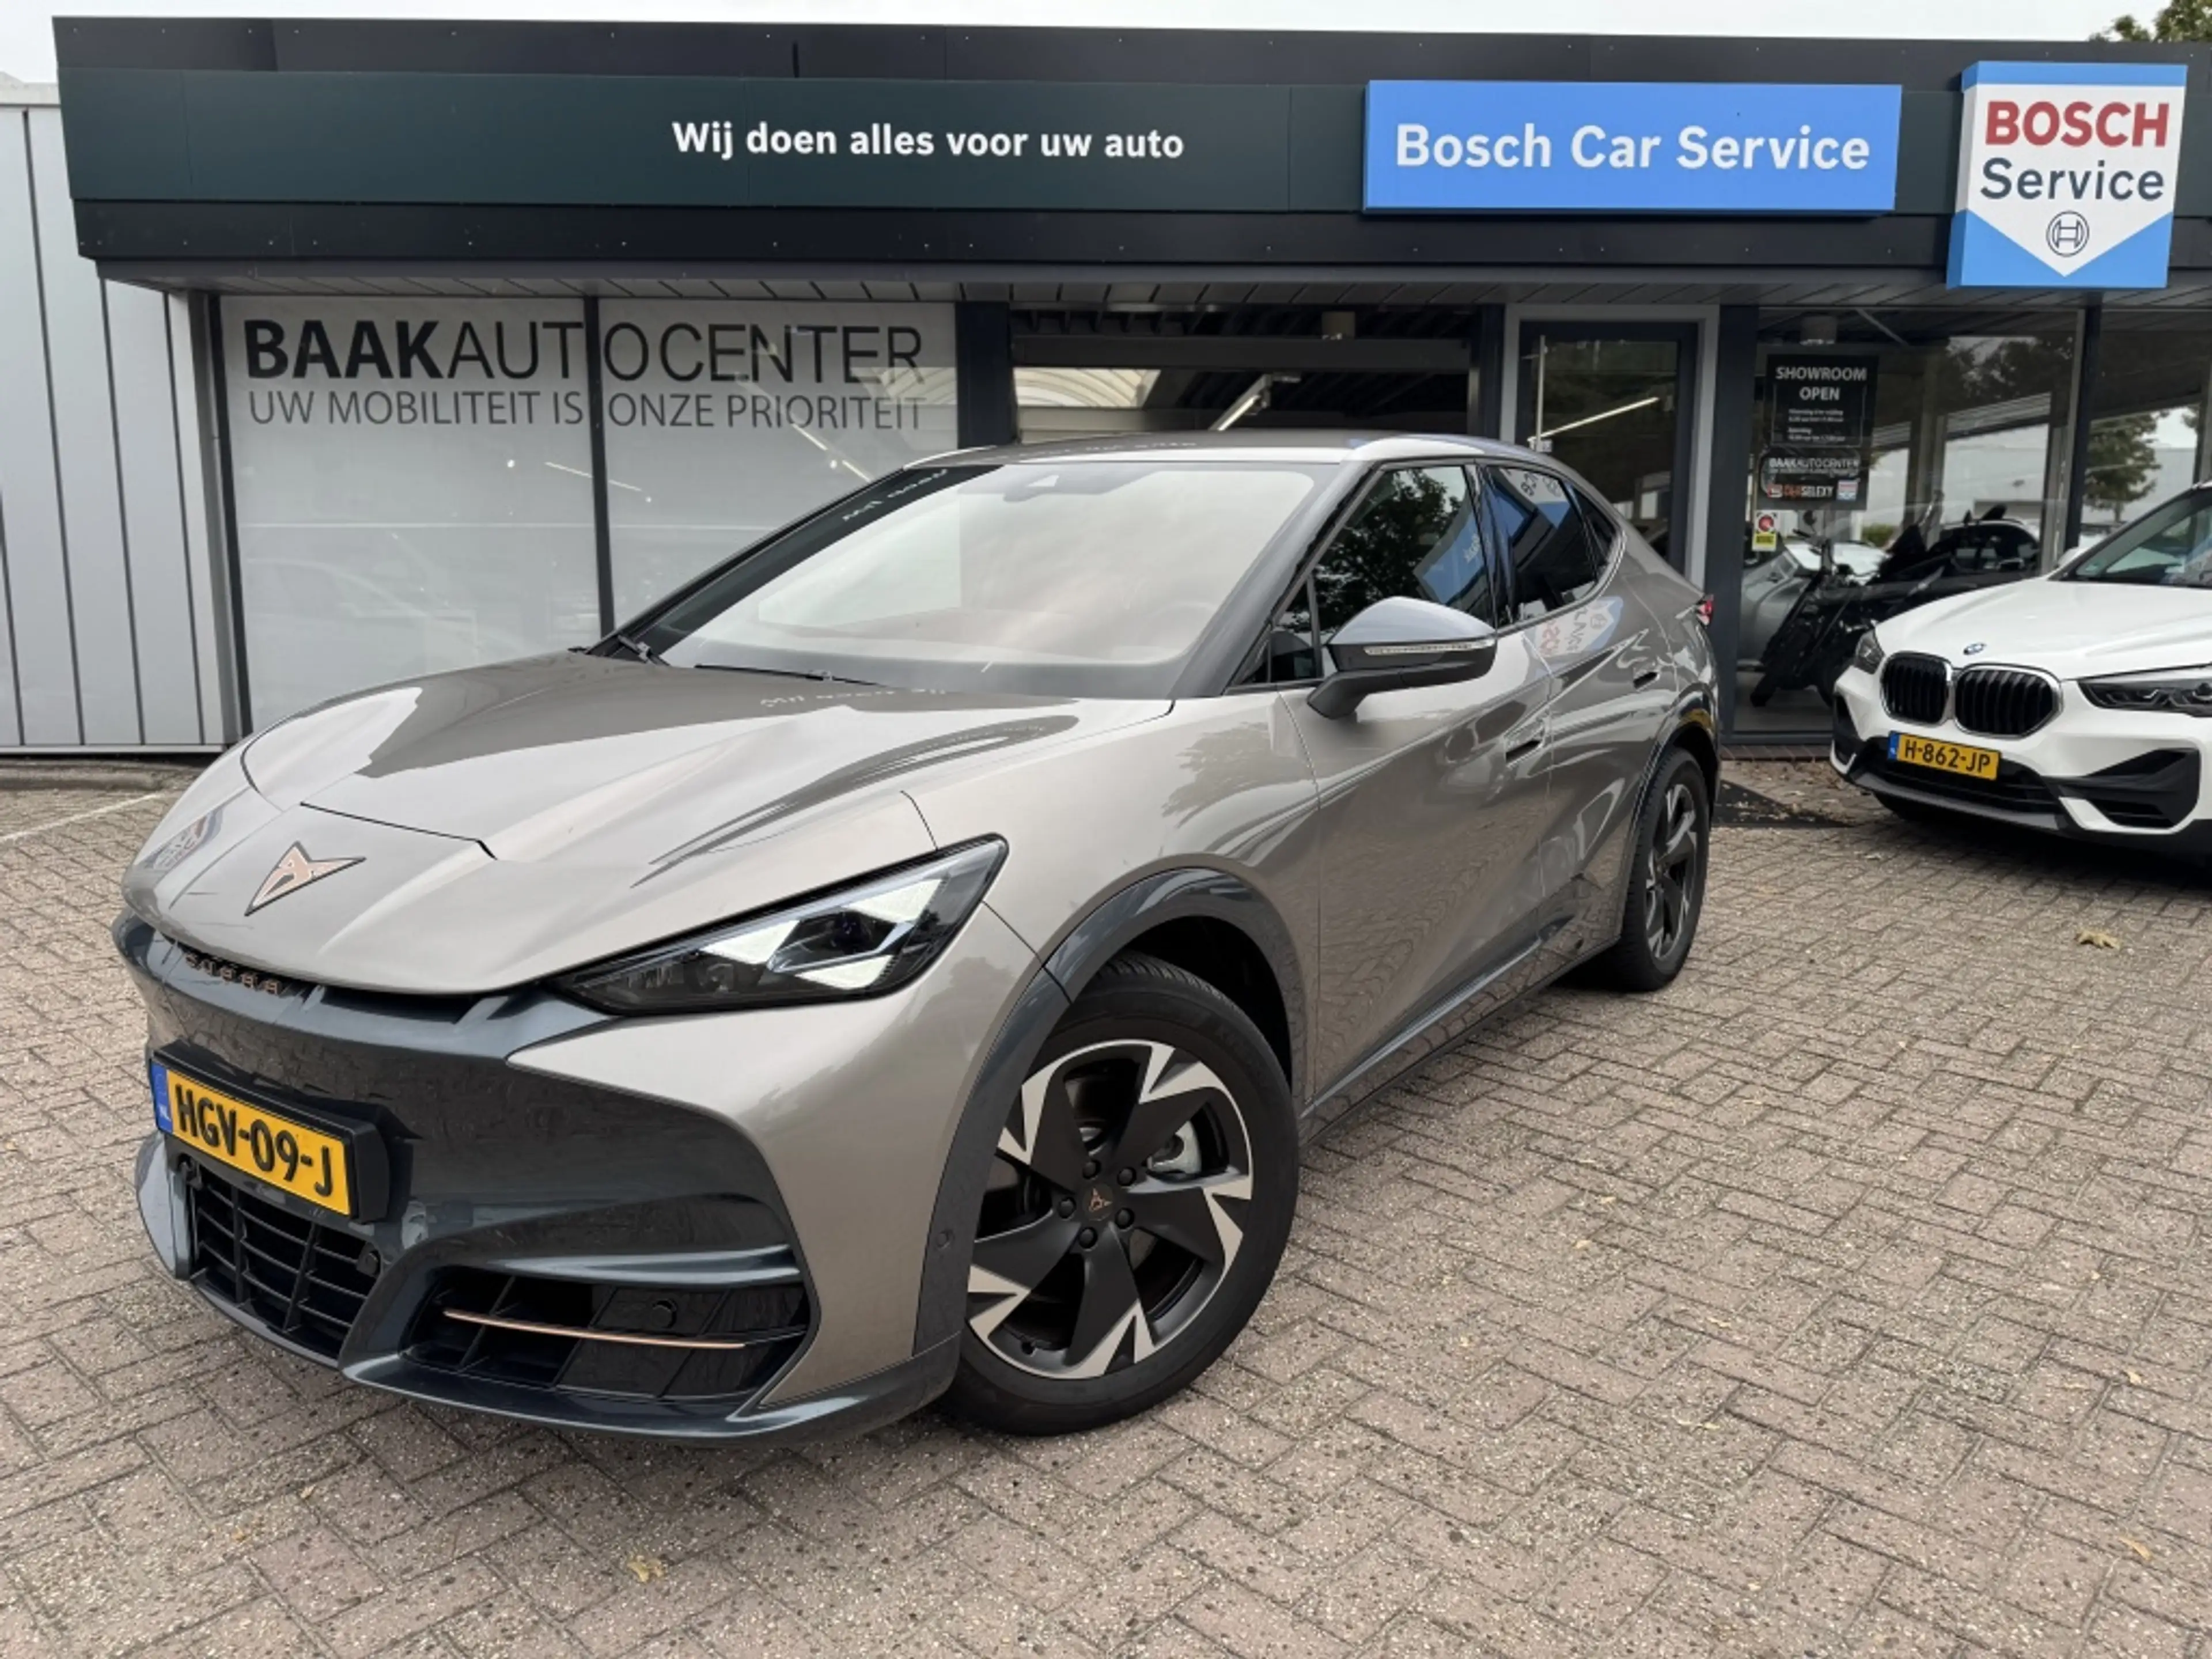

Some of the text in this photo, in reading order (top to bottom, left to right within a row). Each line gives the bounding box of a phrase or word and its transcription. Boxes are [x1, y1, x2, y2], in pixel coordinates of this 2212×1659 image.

[672, 120, 1184, 160] Wij doen alles voor uw auto
[1985, 100, 2170, 147] BOSCH
[1396, 123, 1870, 169] Bosch Car Service
[1980, 157, 2164, 201] Service
[1775, 366, 1868, 381] SHOWROOM
[1799, 386, 1841, 401] OPEN
[249, 390, 927, 430] UW MOBILITEIT IS ONZE PRIORITEIT
[1904, 738, 1990, 772] H-862-JP
[175, 1083, 333, 1198] HGV-09-J
